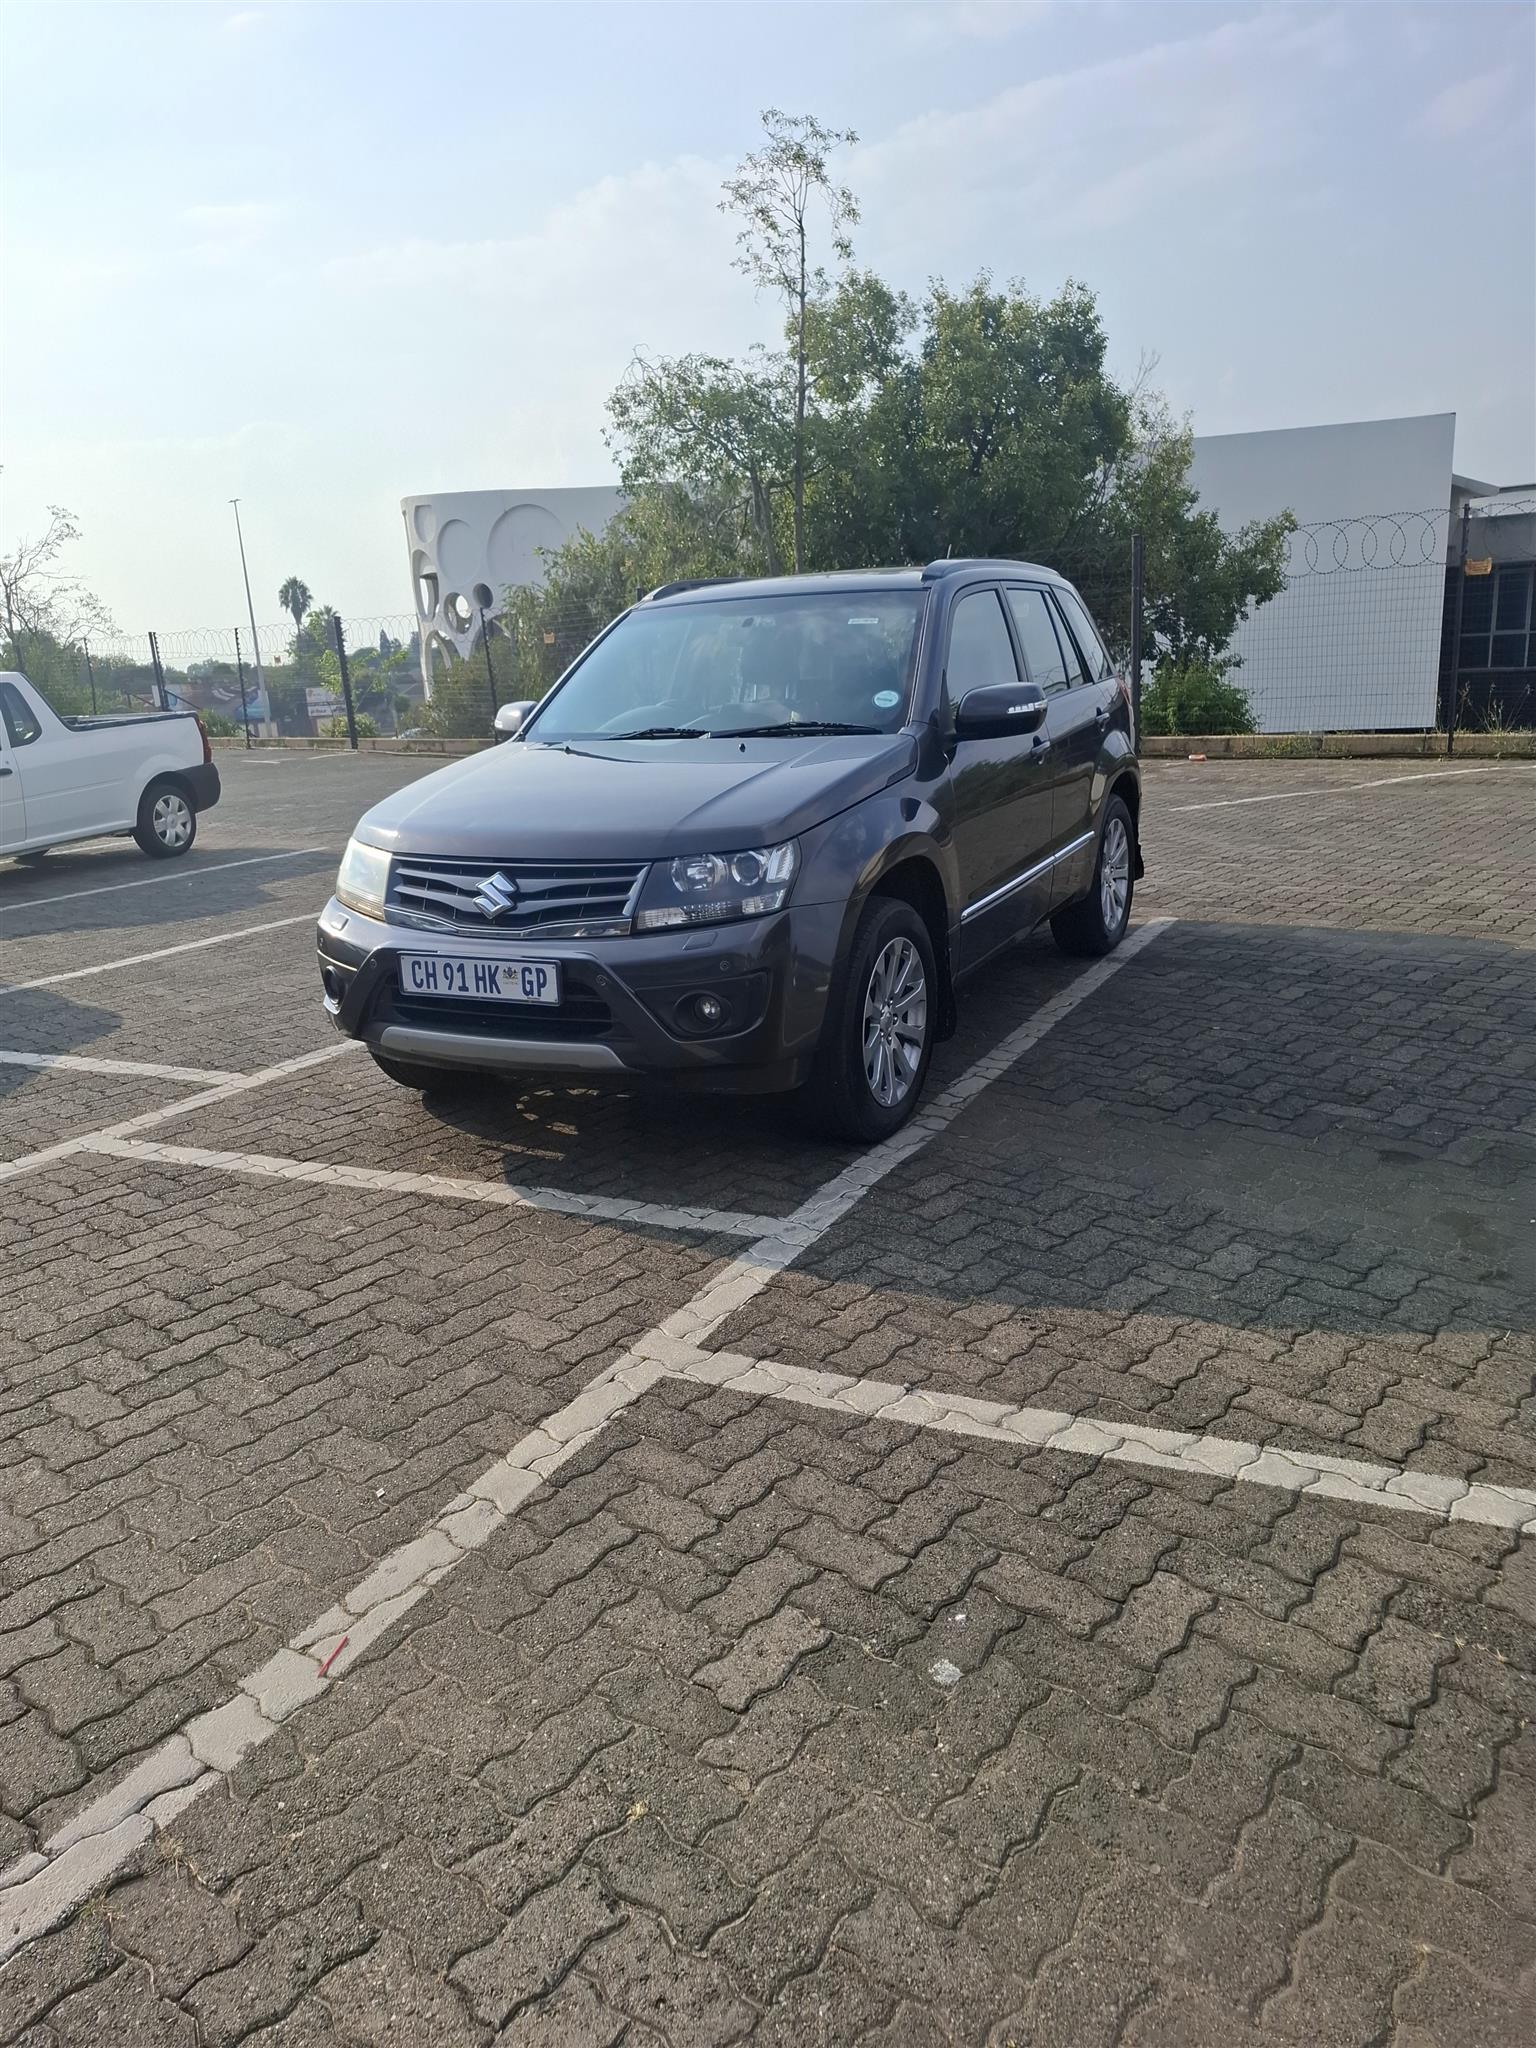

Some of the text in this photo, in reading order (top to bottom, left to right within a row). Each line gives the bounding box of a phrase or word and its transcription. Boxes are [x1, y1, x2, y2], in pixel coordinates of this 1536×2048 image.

[411, 960, 548, 997] CH 91 HK GP
